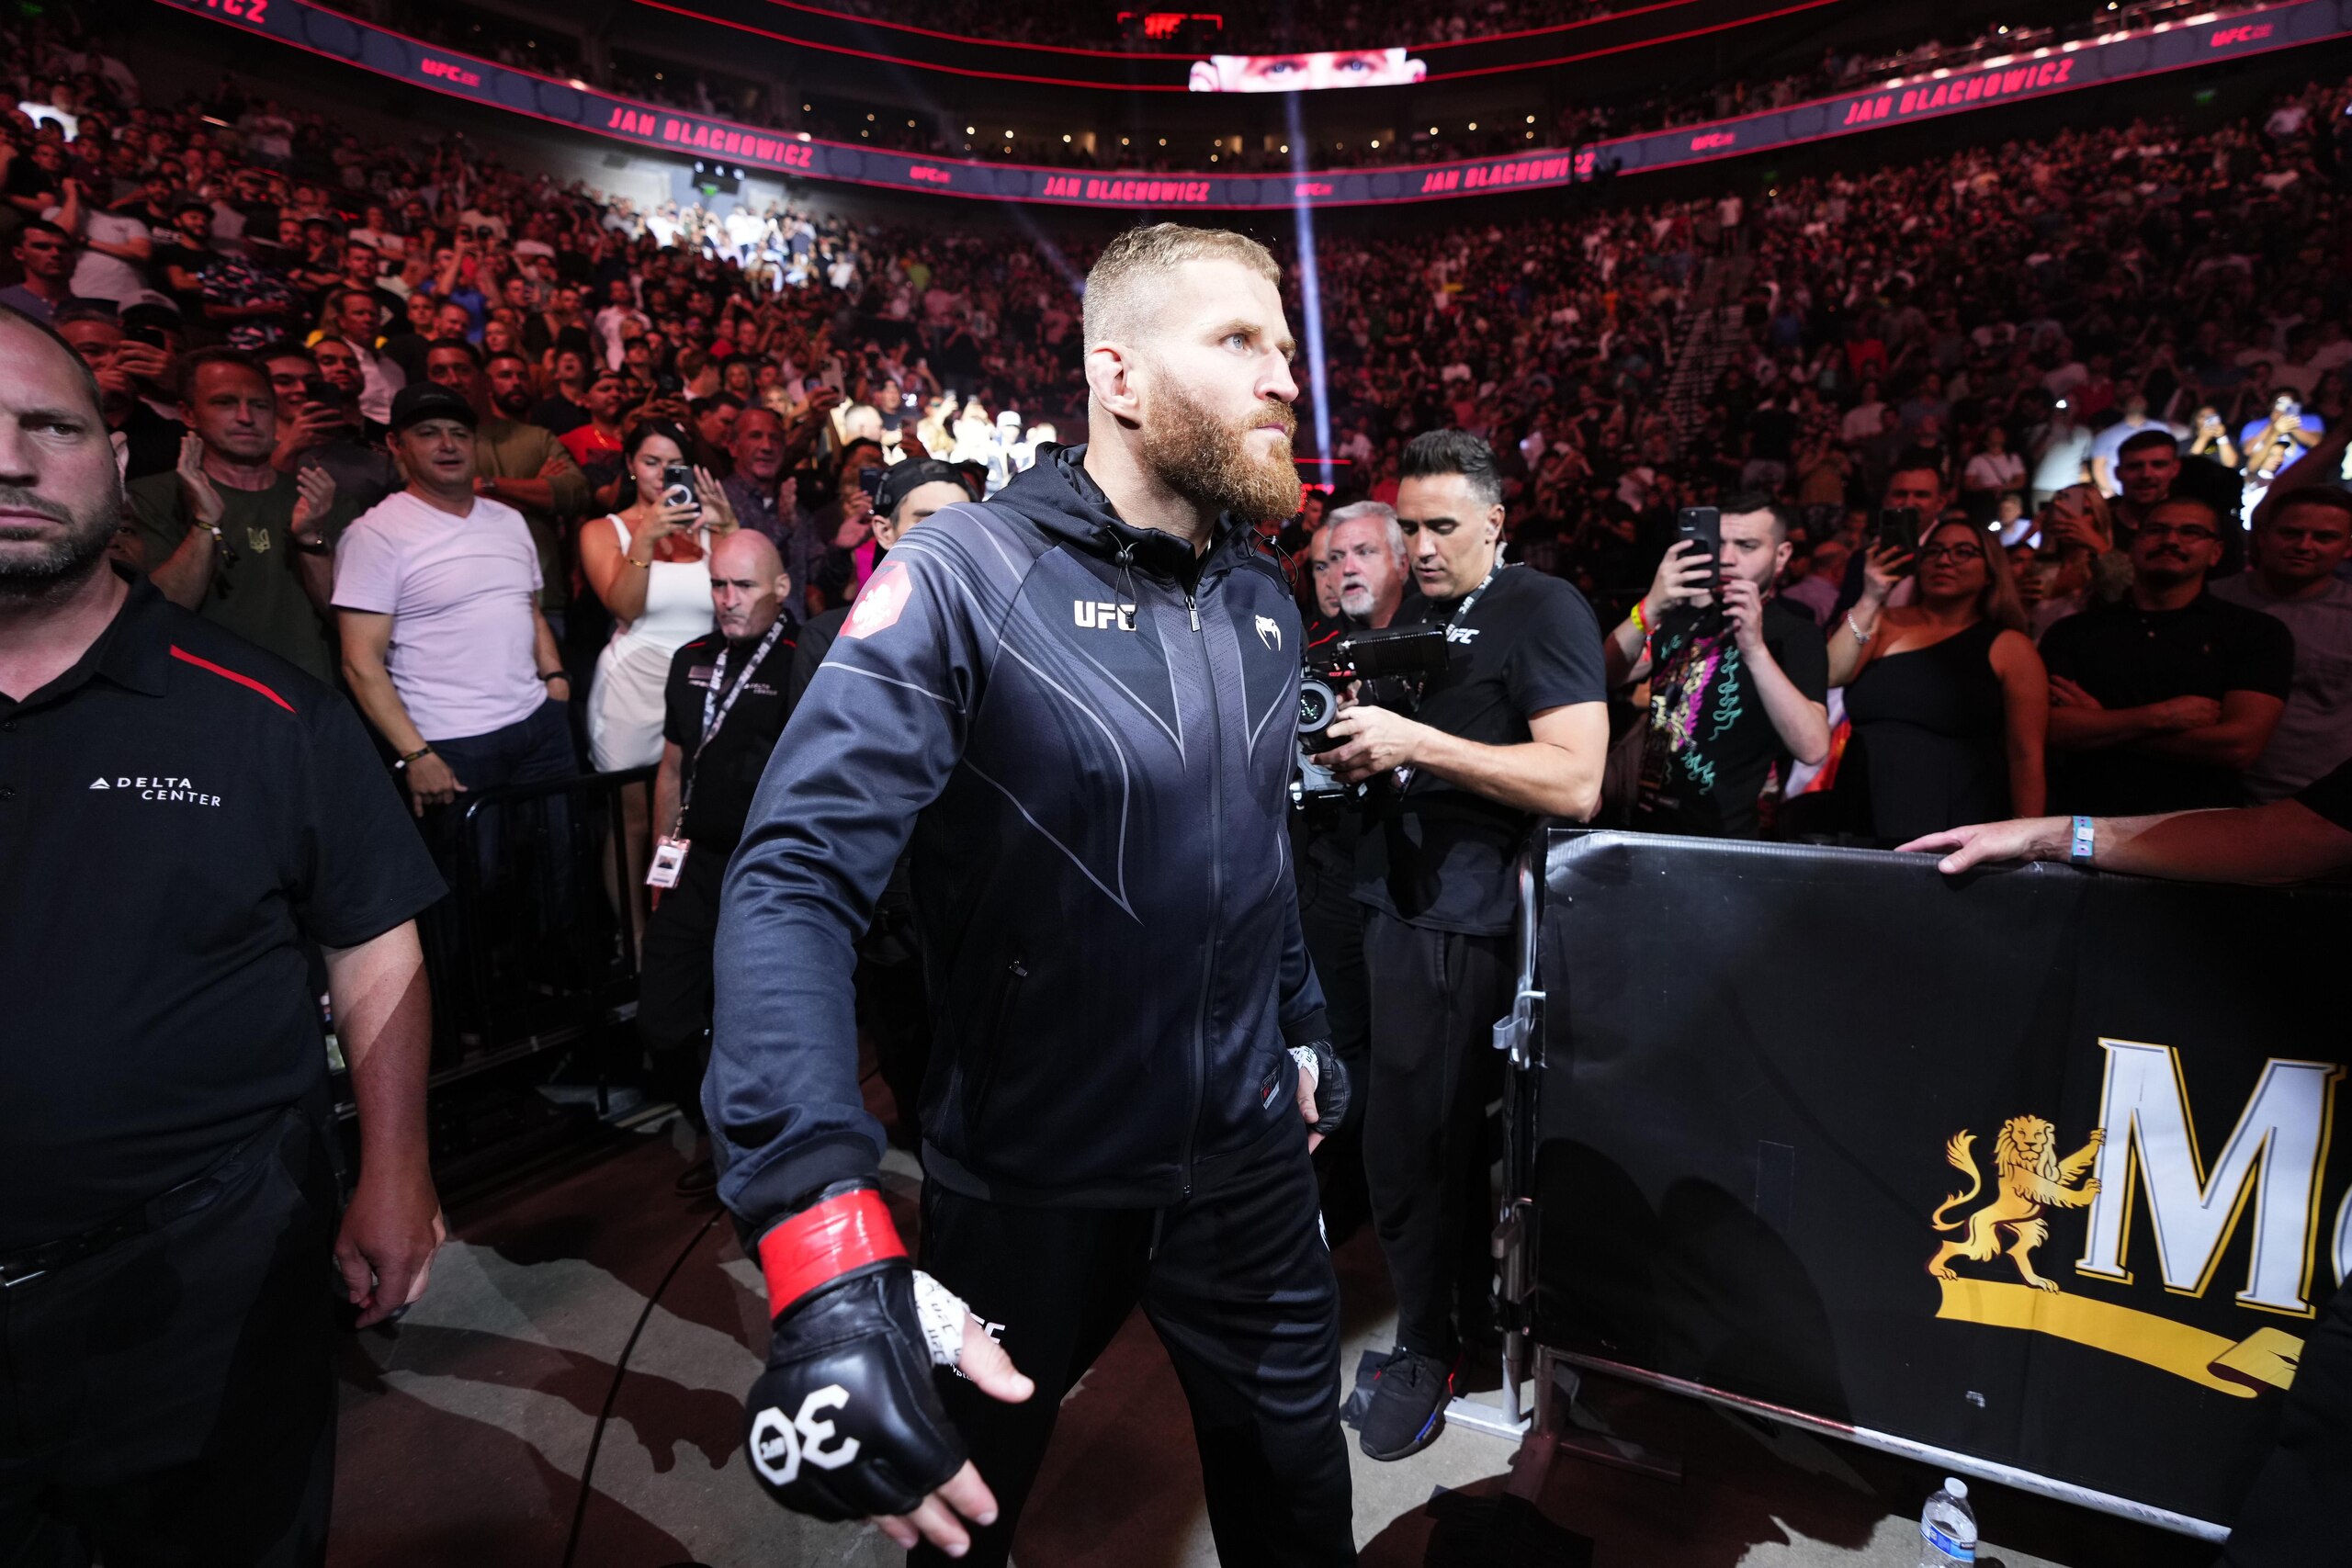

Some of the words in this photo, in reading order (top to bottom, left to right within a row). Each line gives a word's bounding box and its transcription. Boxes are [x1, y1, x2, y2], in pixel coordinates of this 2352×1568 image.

[422, 58, 461, 82] UFC
[1844, 95, 1893, 125] JAN
[1899, 58, 2075, 114] BLACHOWICZ
[607, 107, 656, 137] JAN
[663, 118, 813, 168] BLACHOWICZ
[1044, 176, 1081, 197] JAN
[1086, 179, 1210, 202] BLACHOWICZ
[1421, 169, 1461, 193] JAN
[1074, 600, 1136, 631] UFC
[117, 777, 192, 789] DELTA
[141, 790, 221, 807] CENTER
